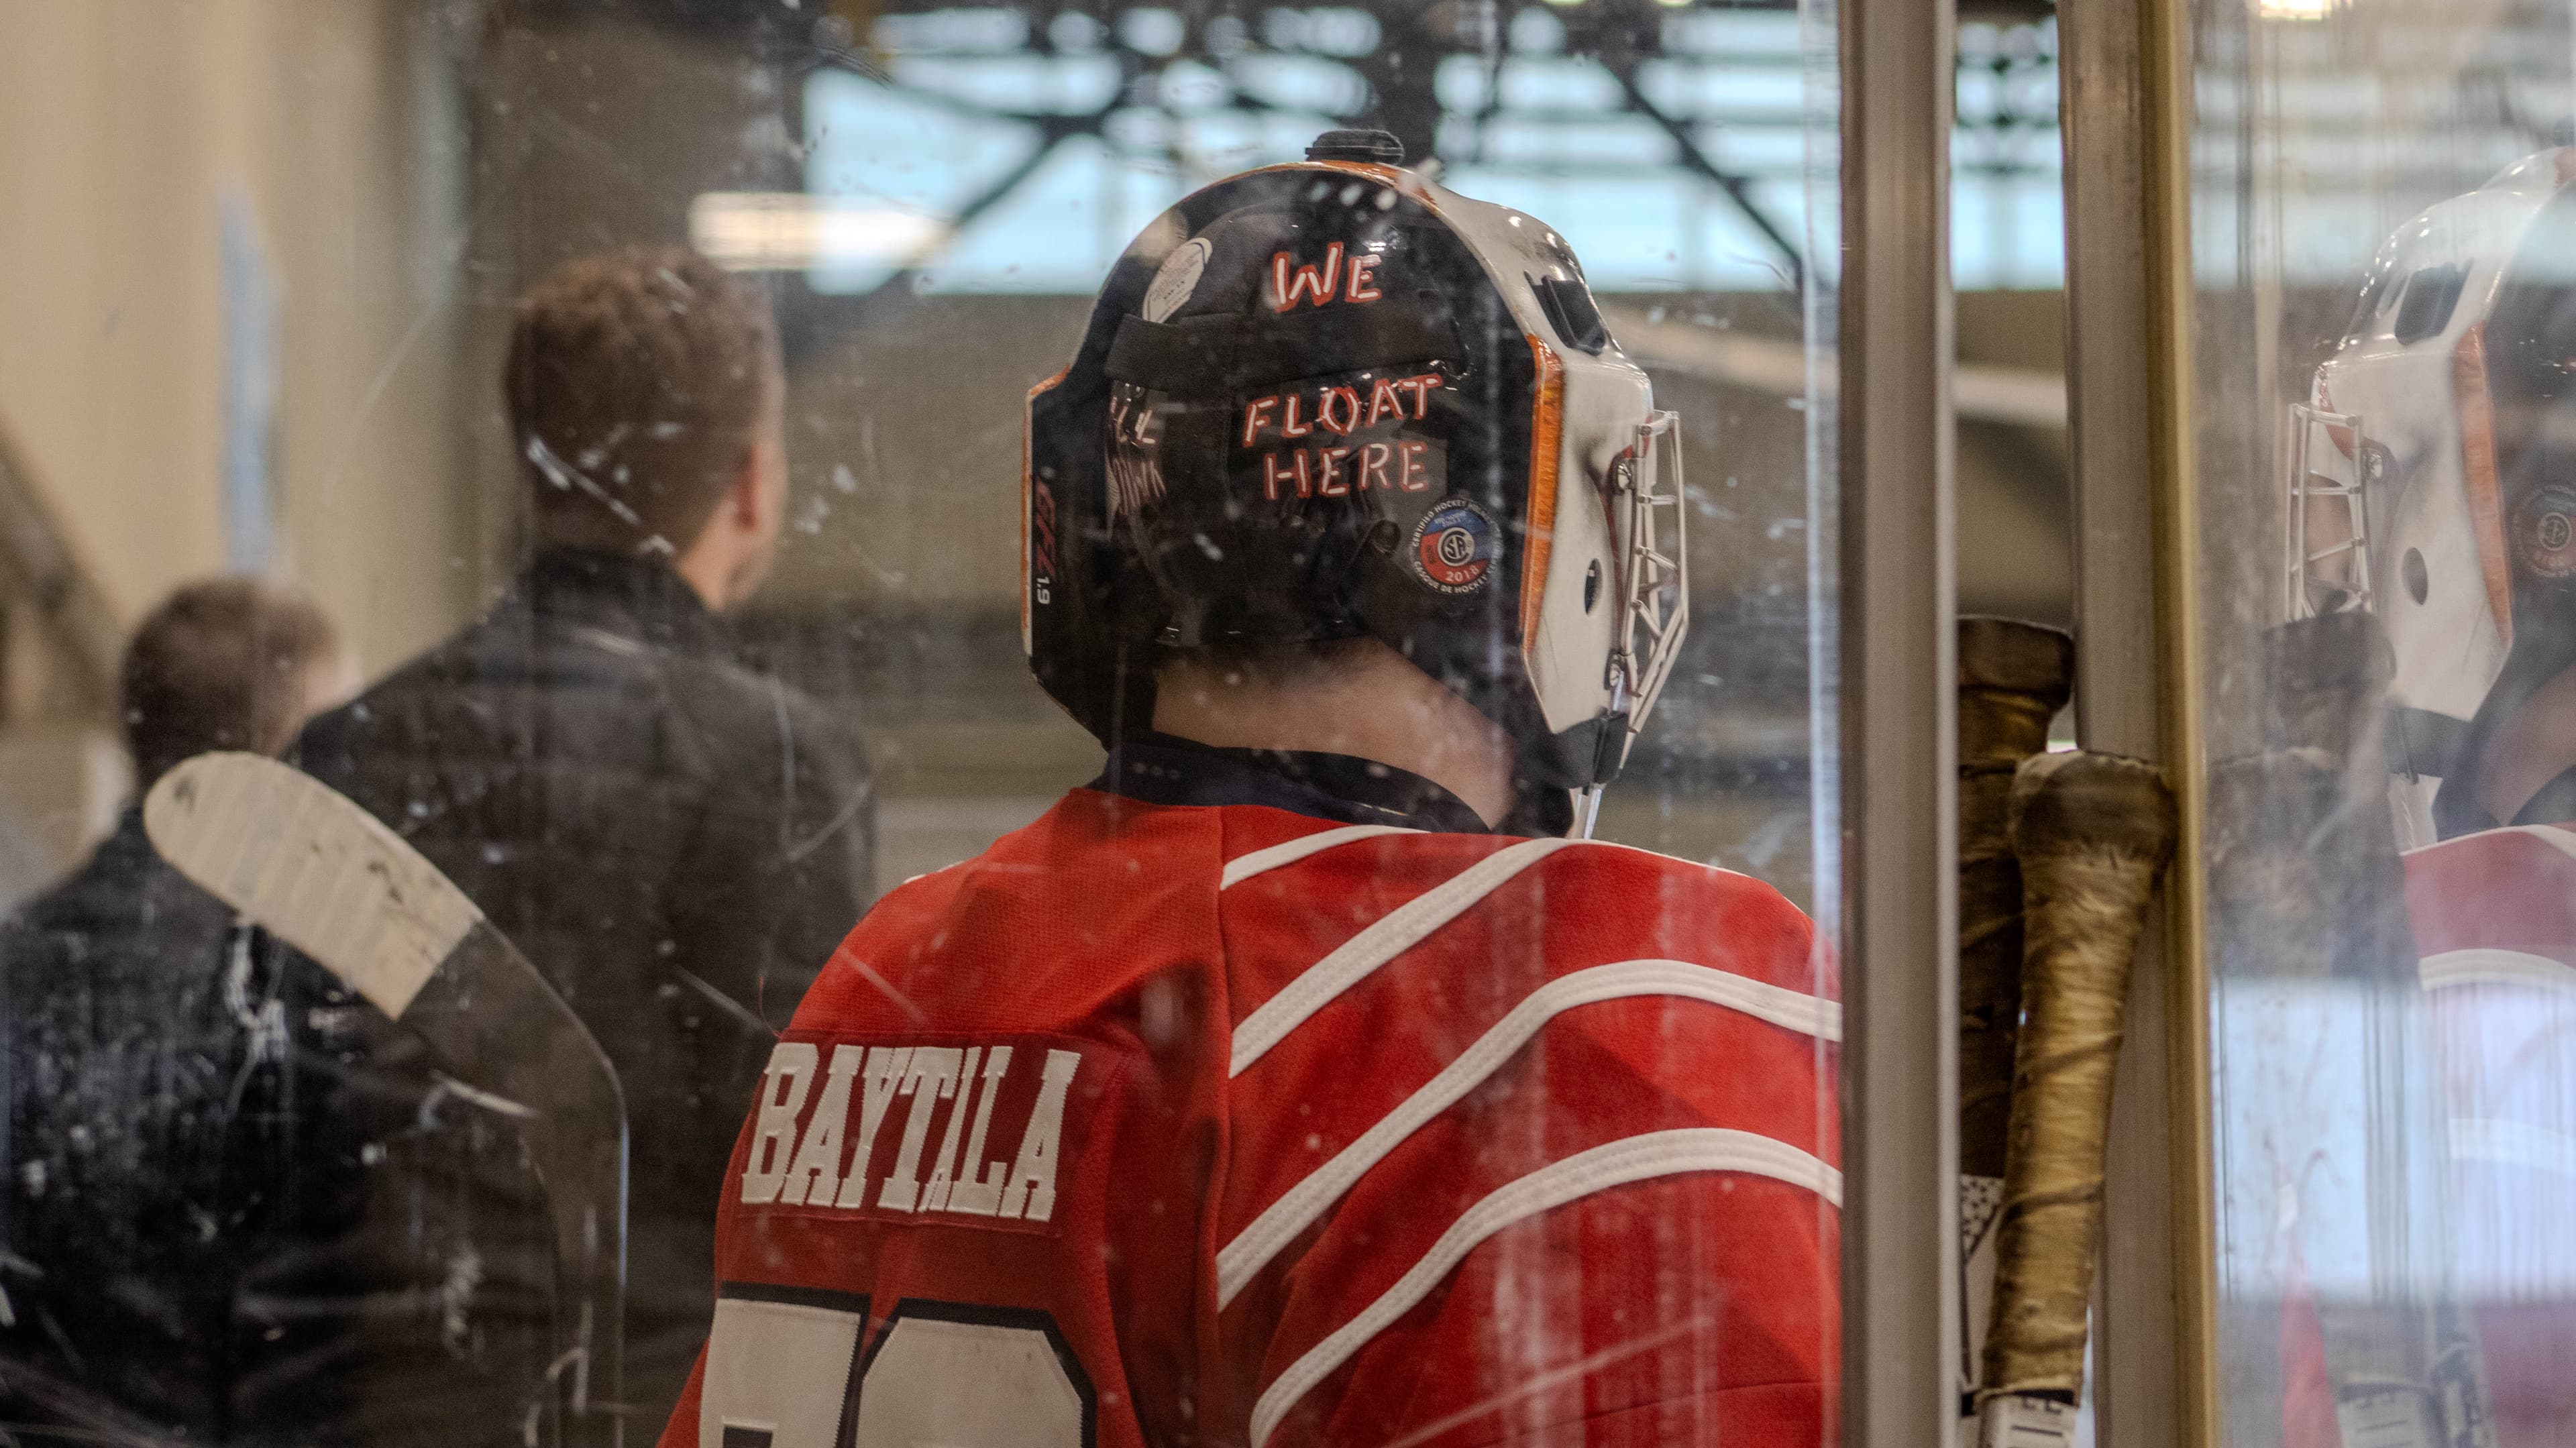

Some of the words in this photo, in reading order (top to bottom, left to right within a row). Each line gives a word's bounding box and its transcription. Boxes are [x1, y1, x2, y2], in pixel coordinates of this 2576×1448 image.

[1273, 241, 1383, 313] WE
[1243, 374, 1442, 448] FLOAT
[1264, 441, 1429, 500] HERE
[1434, 499, 1466, 513] HOCKEY
[1440, 584, 1453, 594] DE
[1454, 573, 1488, 594] HOCKEY
[1444, 565, 1480, 582] 2018
[1036, 576, 1051, 604] 1.9
